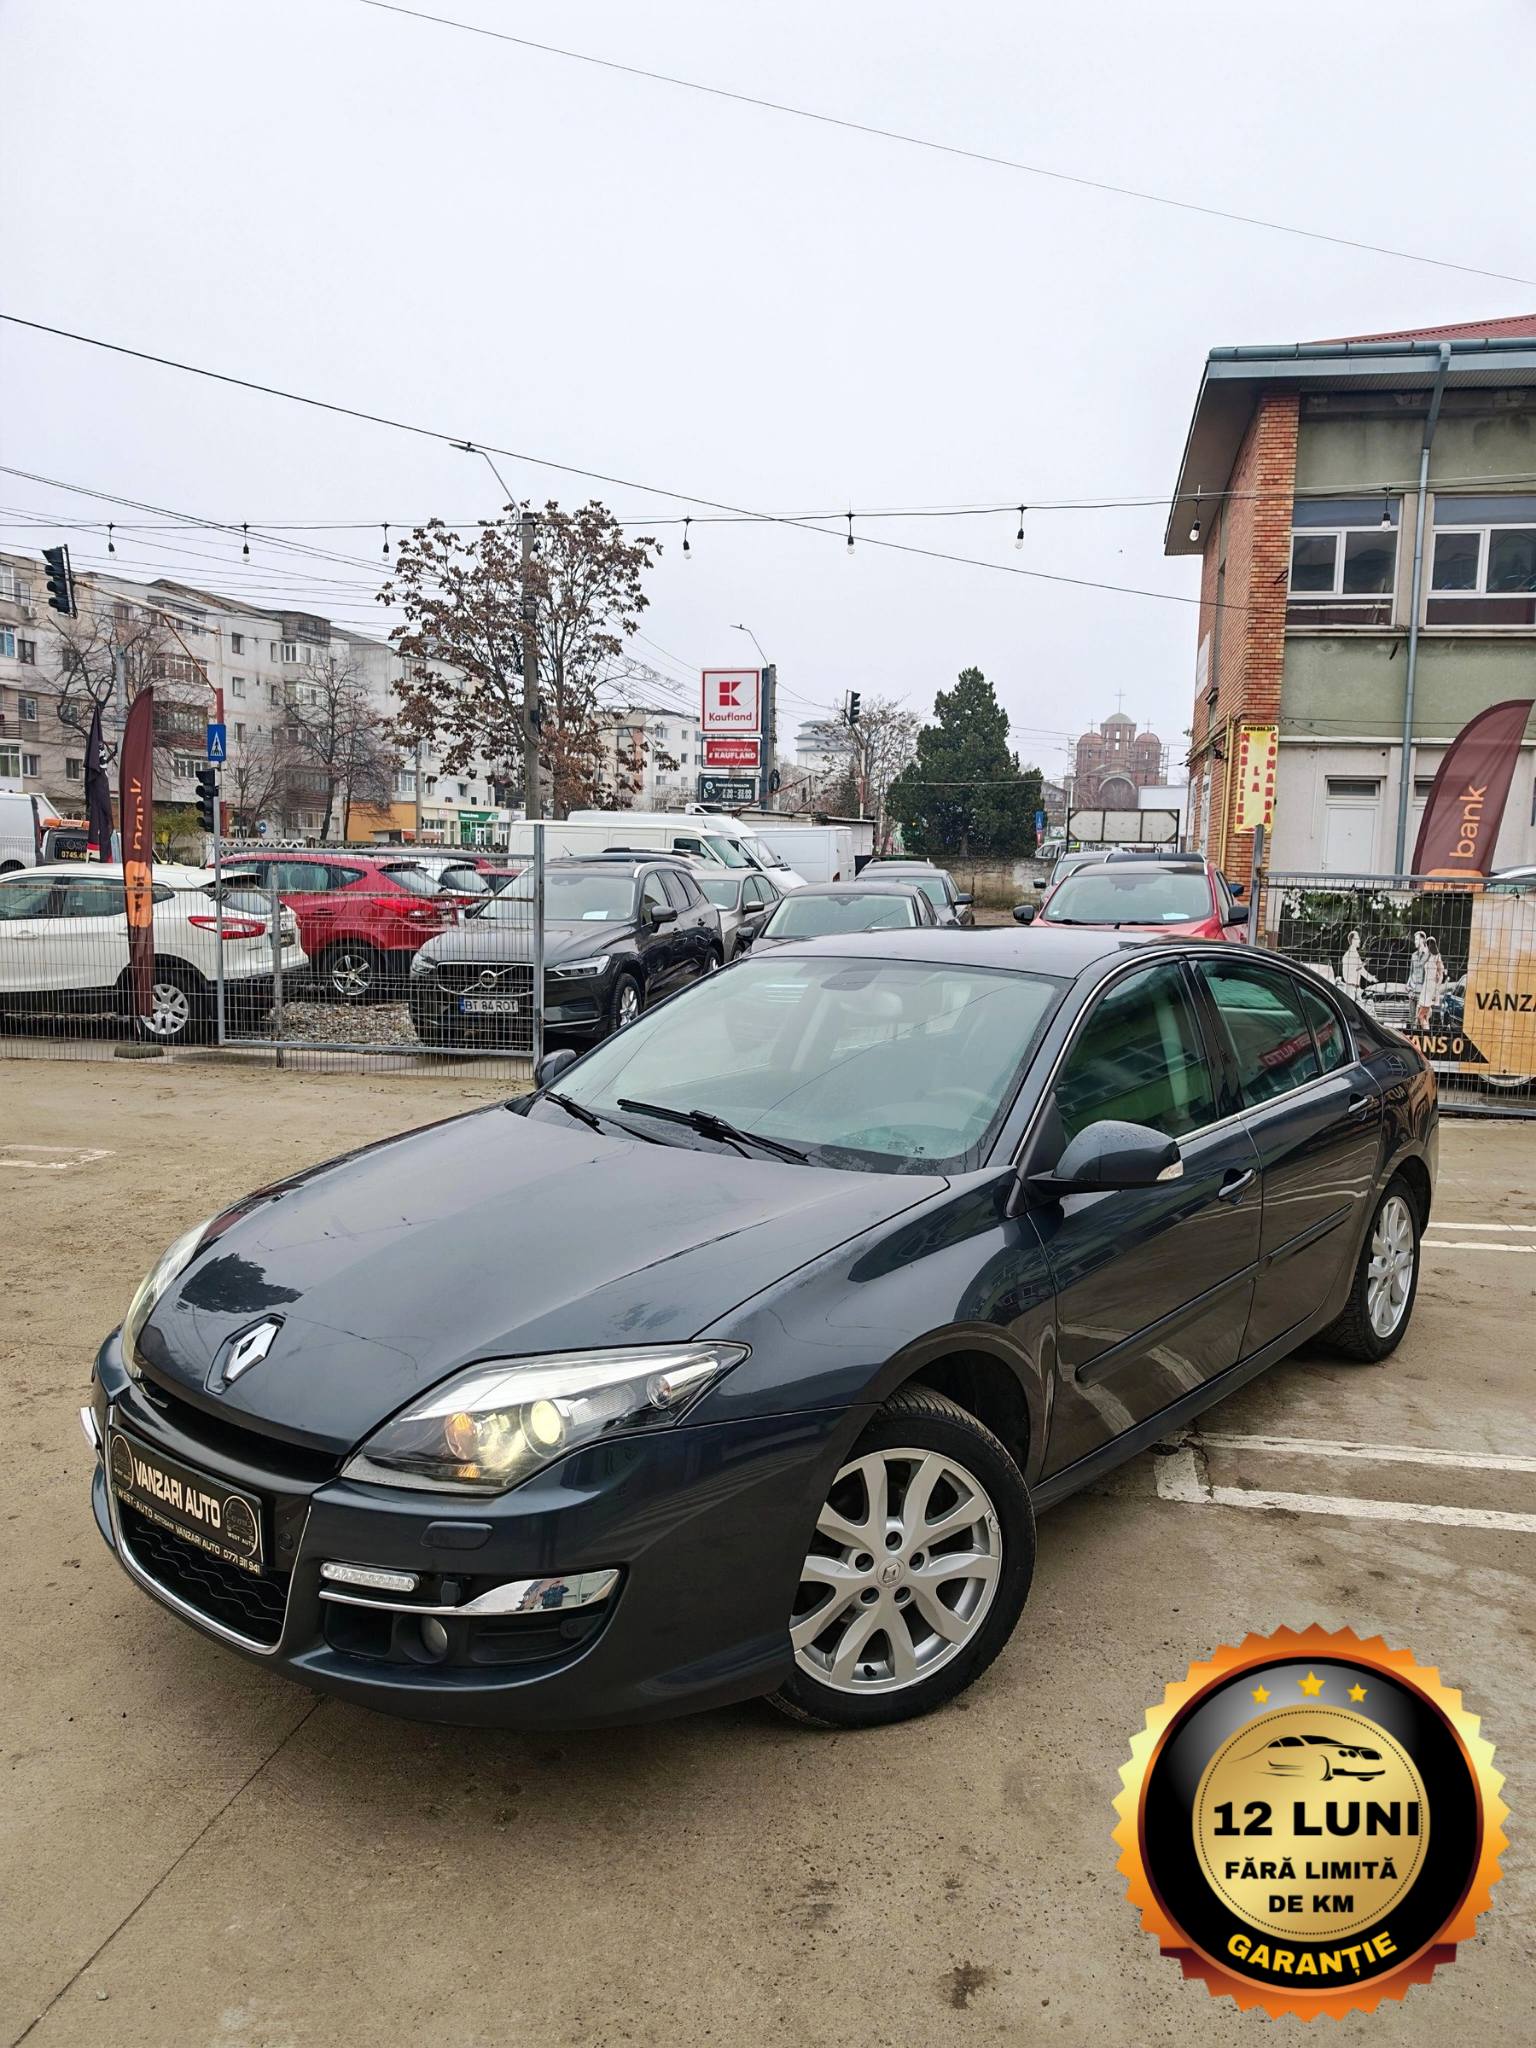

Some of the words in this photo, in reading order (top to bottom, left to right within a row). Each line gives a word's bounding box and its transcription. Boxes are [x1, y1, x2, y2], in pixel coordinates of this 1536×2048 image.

[708, 712, 753, 722] Kaufland
[1236, 732, 1251, 825] MOBILIER
[1251, 765, 1260, 793] LA
[1449, 784, 1488, 858] bank
[465, 1000, 480, 1012] BT
[481, 1000, 494, 1012] 84
[496, 1000, 516, 1012] ROT
[1475, 988, 1536, 1013] VÂNZ
[133, 1457, 183, 1511] VANZARI
[185, 1487, 221, 1529] AUTO
[175, 1524, 202, 1545] VANZARI
[202, 1539, 221, 1555] AUTO
[223, 1549, 239, 1564] 0771
[239, 1556, 248, 1568] 311
[248, 1561, 261, 1575] 941
